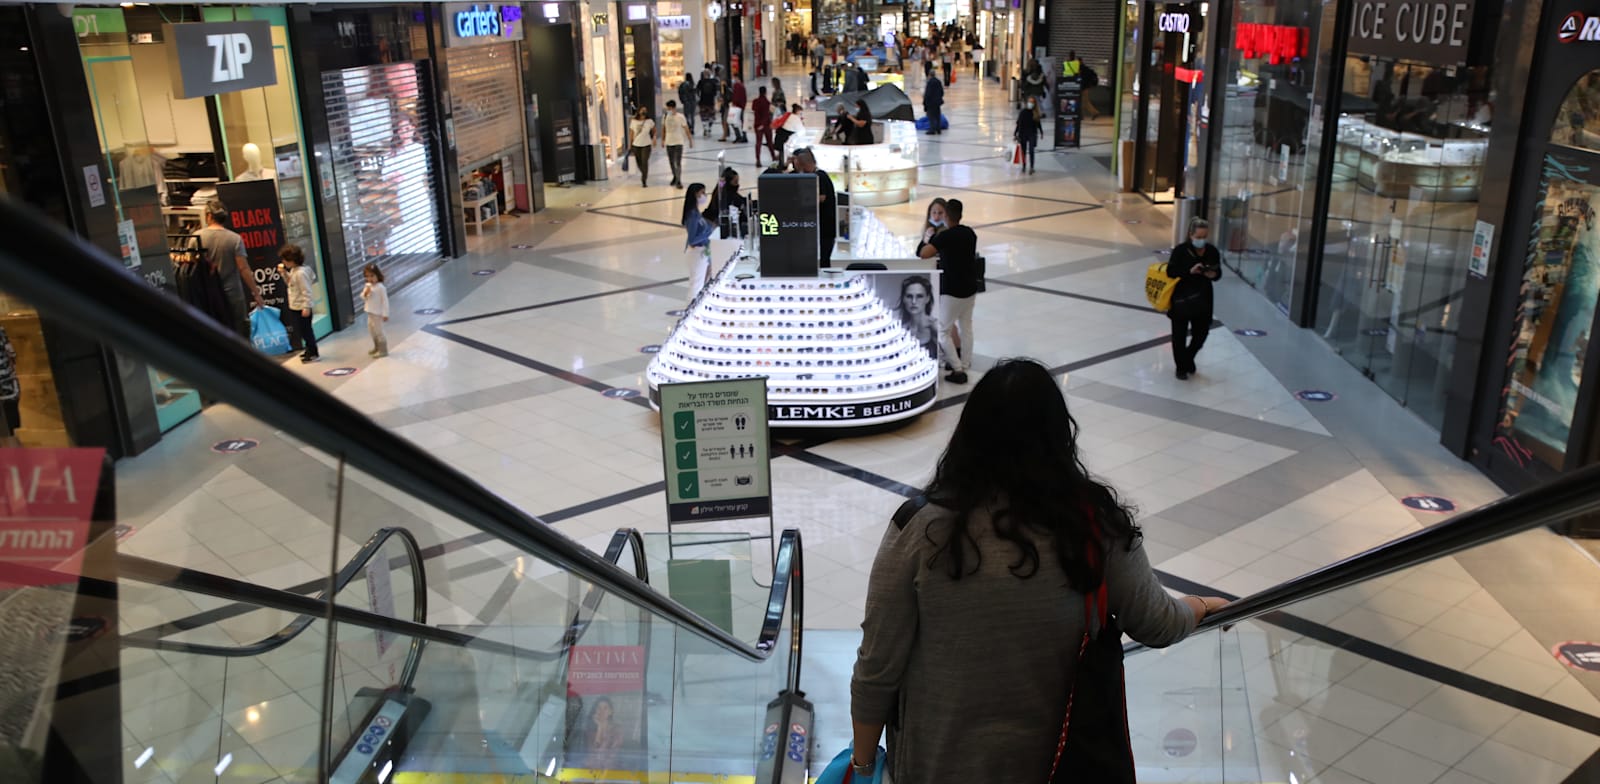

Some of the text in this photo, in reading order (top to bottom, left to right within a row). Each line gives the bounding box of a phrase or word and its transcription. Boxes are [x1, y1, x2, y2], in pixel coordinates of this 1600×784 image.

[457, 4, 499, 38] carter's
[1158, 12, 1190, 33] CASTRO
[1350, 2, 1467, 46] ICE CUBE
[205, 32, 253, 83] ZIP
[230, 208, 273, 229] BLACK
[240, 229, 278, 250] RIDAY
[254, 267, 281, 284] 0%
[678, 397, 749, 409] הנחיות משרד הבריאות
[687, 390, 739, 400] שומרים ביחד על
[776, 400, 912, 419] LEMKE BERLIN
[574, 651, 639, 665] INTIMA
